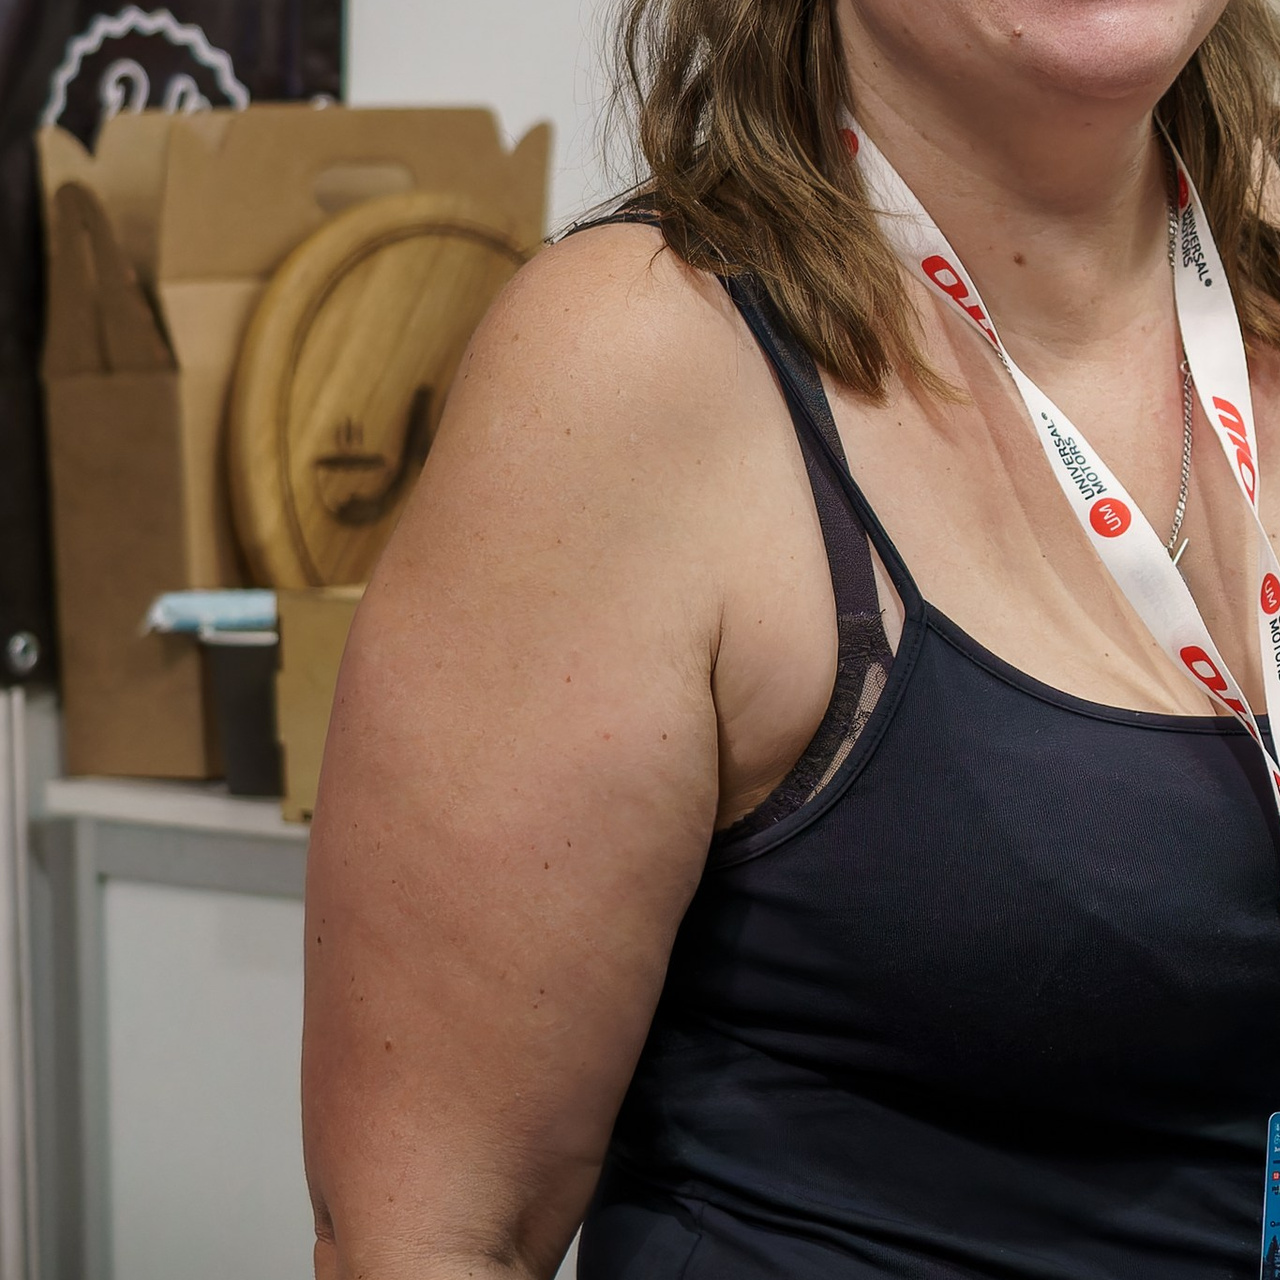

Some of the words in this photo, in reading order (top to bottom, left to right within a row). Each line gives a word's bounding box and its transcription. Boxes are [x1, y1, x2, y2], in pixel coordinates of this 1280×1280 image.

[1064, 437, 1107, 495] MOTORS
[1098, 504, 1122, 531] UM
[1264, 580, 1277, 608] UM
